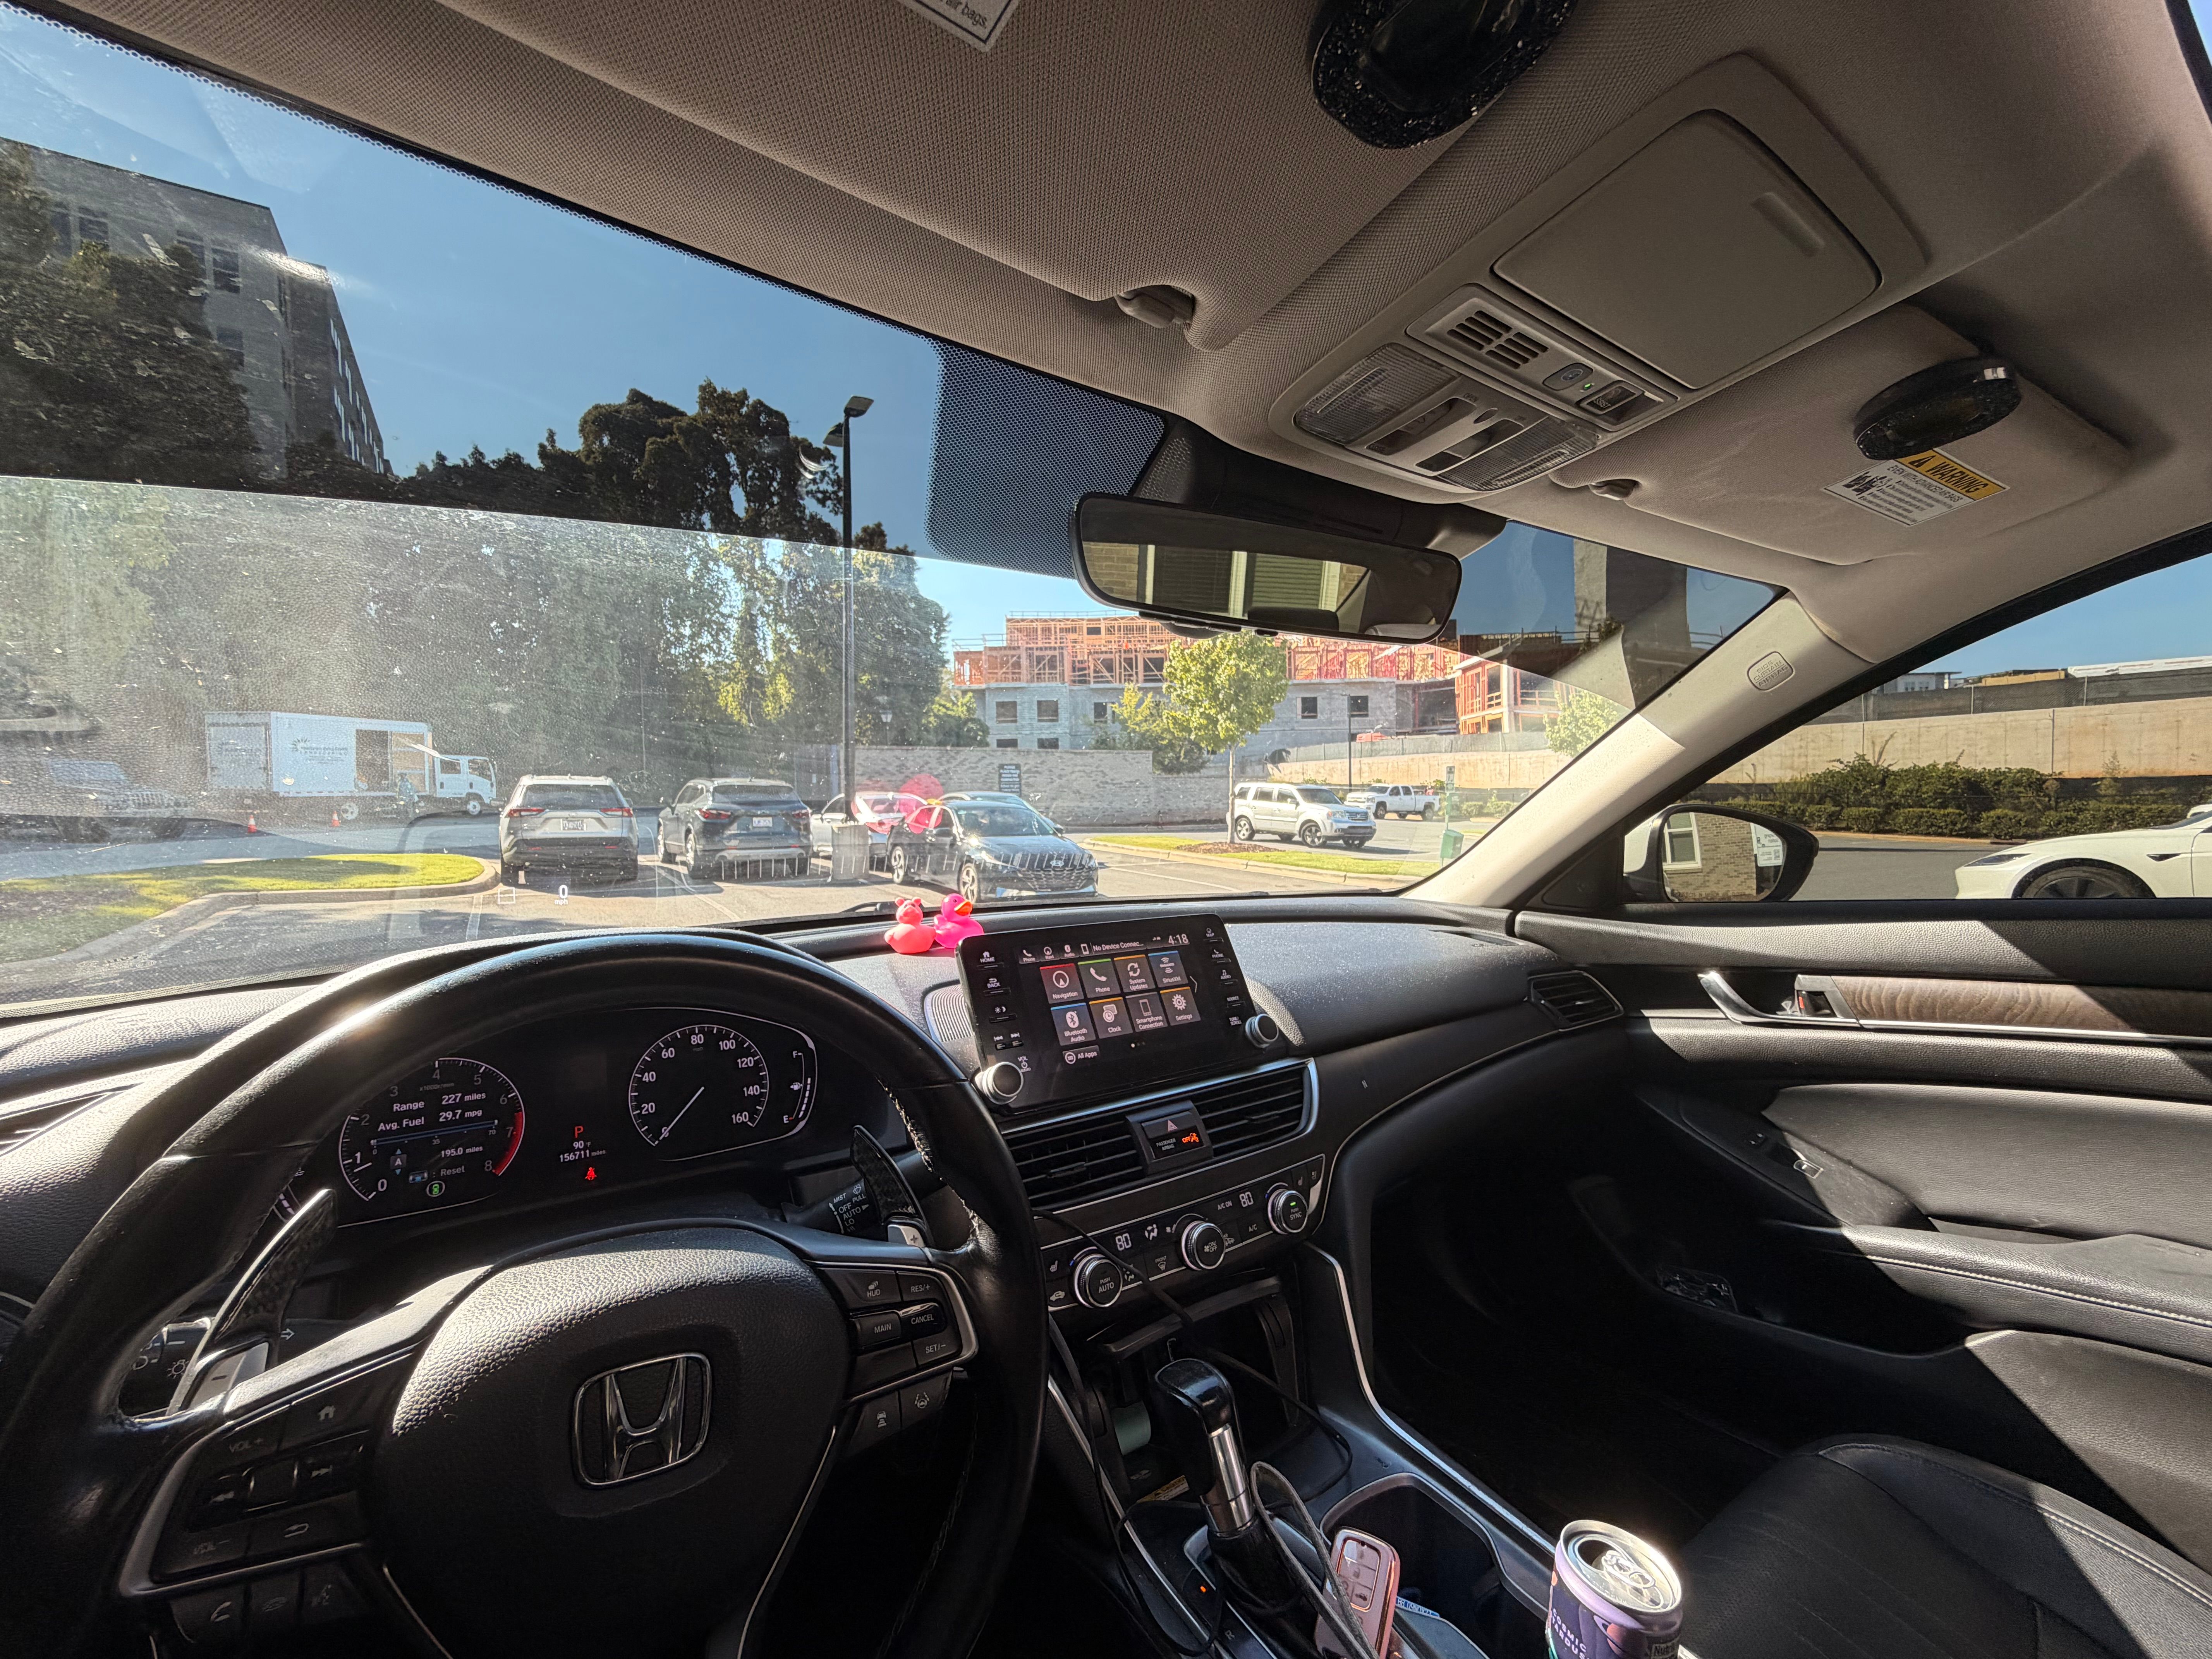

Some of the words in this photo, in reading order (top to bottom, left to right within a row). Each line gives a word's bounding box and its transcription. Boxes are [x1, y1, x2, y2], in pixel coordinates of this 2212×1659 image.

[960, 1, 987, 29] bags.
[1925, 461, 1989, 493] WARNING
[1754, 660, 1783, 681] CURTAIN
[1757, 660, 1774, 673] SIDE
[1759, 665, 1788, 687] AIRBAG
[559, 885, 568, 899] 0
[1168, 934, 1188, 945] 4:18
[1052, 991, 1079, 1000] Navigation
[1135, 1015, 1163, 1025] Smartphone
[1175, 1013, 1193, 1022] Settings
[1139, 1021, 1164, 1030] Connection
[1064, 1028, 1087, 1036] Bluetooth
[691, 1034, 704, 1045] 80
[719, 1039, 736, 1051] 100
[661, 1048, 675, 1059] 60
[1084, 1051, 1097, 1060] Apps
[737, 1057, 754, 1068] 120
[432, 1069, 440, 1080] 4
[474, 1074, 481, 1085] 5
[642, 1072, 656, 1082] 40
[389, 1085, 398, 1097] 3
[743, 1085, 760, 1097] 140
[393, 1101, 425, 1112] Range
[441, 1093, 462, 1104] 227
[464, 1092, 486, 1101] miles
[500, 1094, 508, 1104] 6
[641, 1103, 655, 1114] 20
[361, 1114, 370, 1126] 2
[378, 1121, 400, 1132] Avg.
[403, 1116, 424, 1128] Fuel
[439, 1109, 462, 1122] 29.7
[464, 1109, 483, 1118] mpg
[732, 1111, 749, 1124] 160
[783, 1115, 789, 1123] E
[506, 1126, 514, 1138] 7
[575, 1126, 584, 1138] P
[573, 1140, 584, 1149] 90
[1156, 1138, 1176, 1147] PASSENGER
[440, 1147, 464, 1158] 195.0
[465, 1146, 483, 1154] miles
[560, 1149, 589, 1162] 156711
[354, 1152, 361, 1164] 1
[395, 1158, 402, 1166] A
[440, 1165, 465, 1177] Reset
[484, 1160, 493, 1172] 8
[378, 1179, 387, 1192] 0
[833, 1193, 846, 1203] MIST
[852, 1194, 866, 1203] PULL
[1239, 1191, 1254, 1207] 80
[838, 1202, 852, 1213] OFF
[1218, 1202, 1226, 1210] A/C
[843, 1207, 861, 1220] AUTO
[1290, 1211, 1302, 1220] SYNC
[845, 1218, 855, 1226] LO
[1249, 1224, 1258, 1233] A/C
[1115, 1233, 1132, 1251] 80
[867, 1289, 881, 1297] HUD
[911, 1284, 930, 1293] RES/+
[1098, 1282, 1115, 1293] AUTO
[911, 1314, 934, 1324] CANCEL
[874, 1323, 891, 1334] MAIN
[1550, 1610, 1589, 1659] TARDUS
[1553, 1608, 1586, 1652] COSMIC
